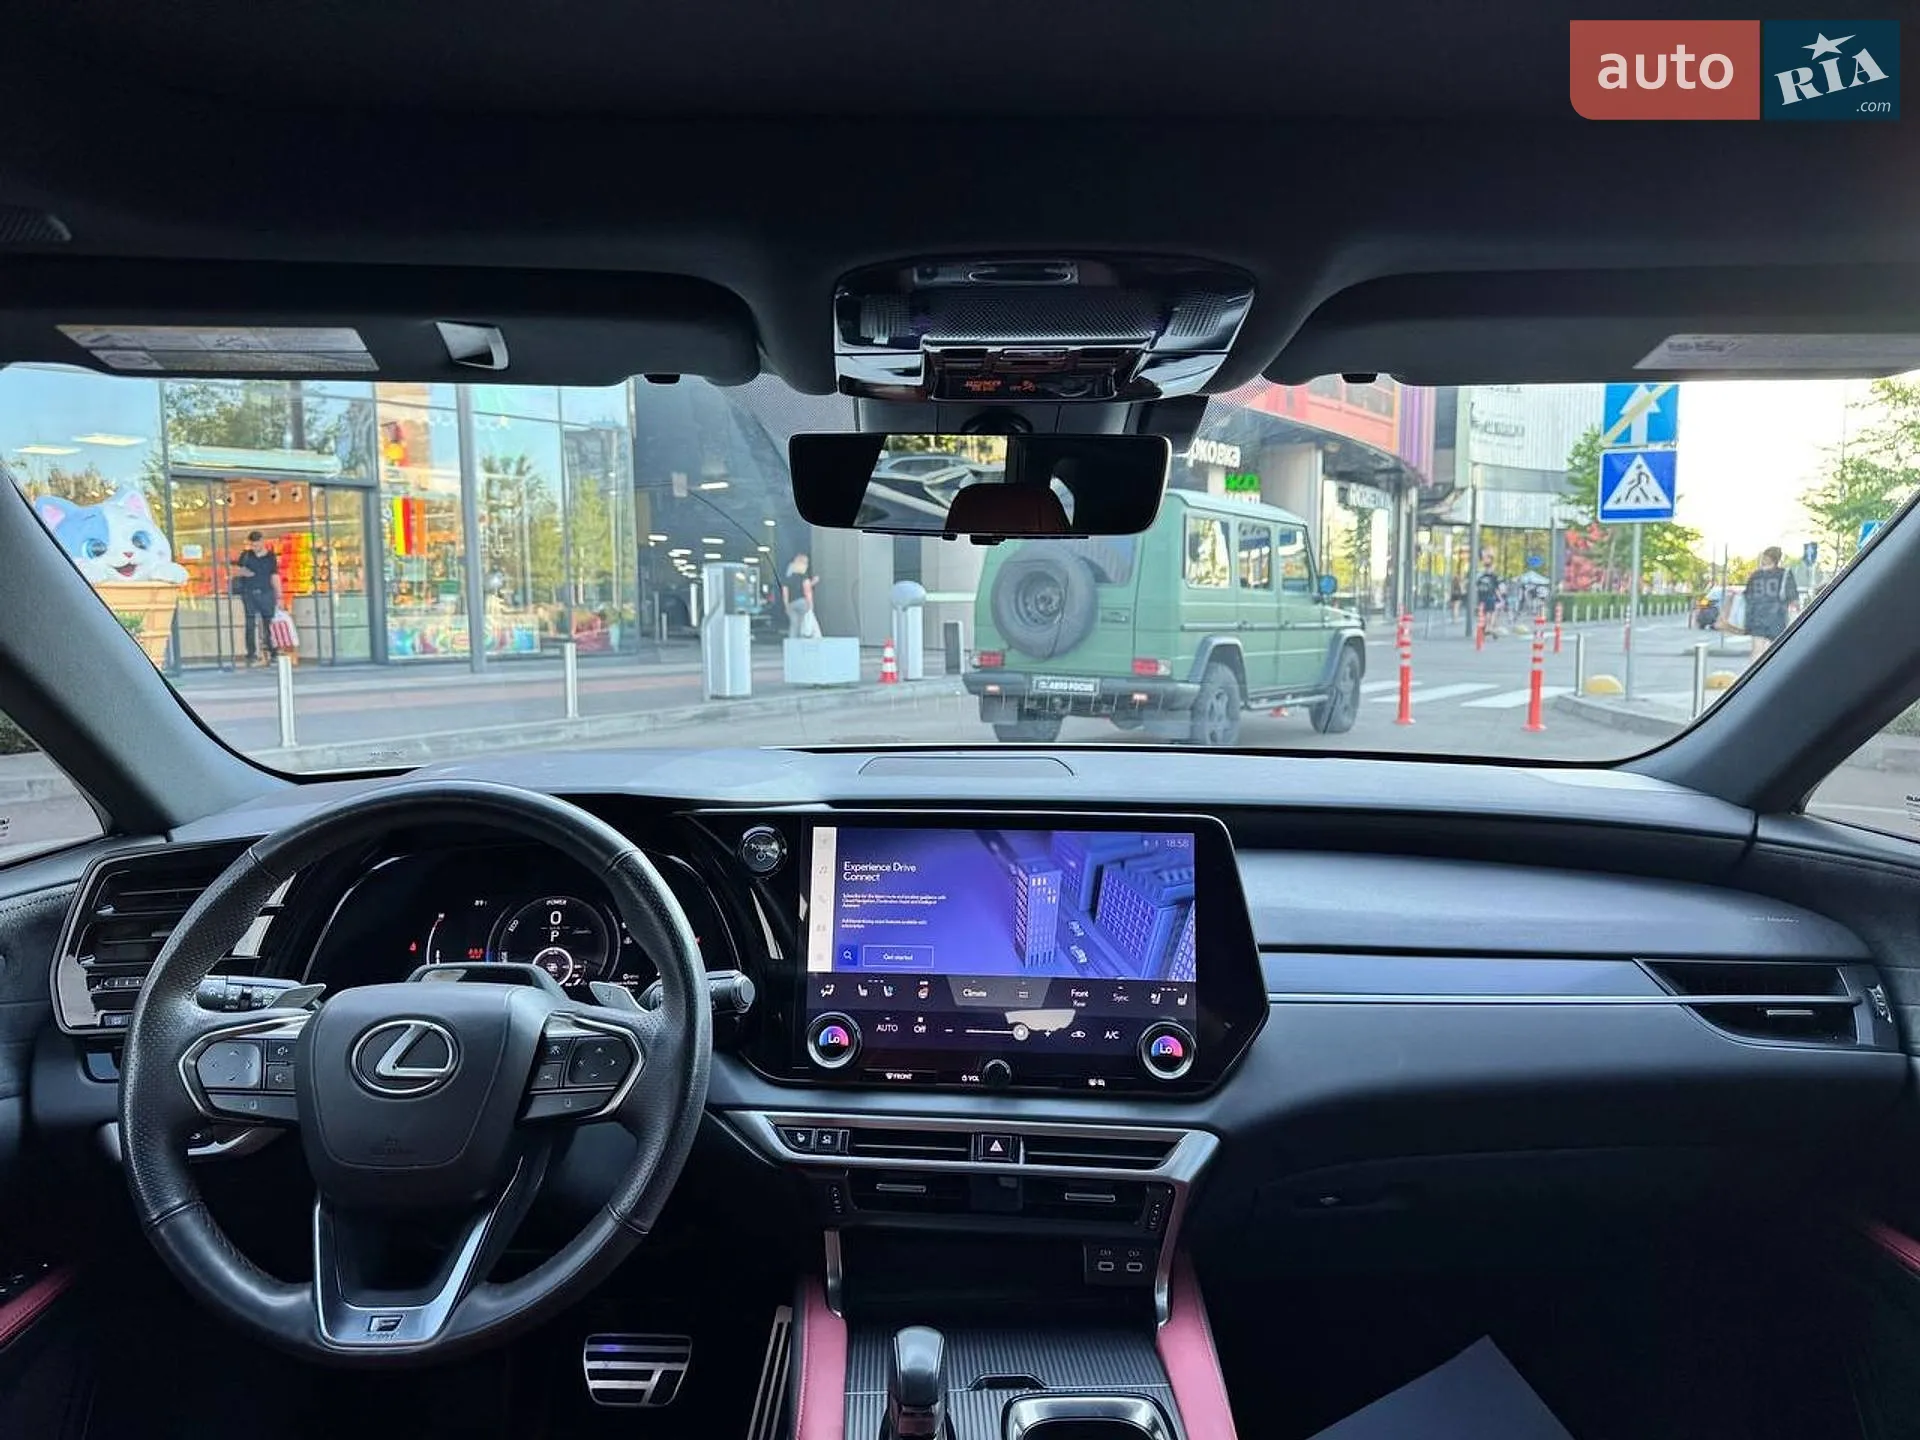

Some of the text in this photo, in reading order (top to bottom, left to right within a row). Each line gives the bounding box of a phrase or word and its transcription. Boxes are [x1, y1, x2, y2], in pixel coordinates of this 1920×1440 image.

[844, 861, 917, 873] Experience Drive
[843, 872, 880, 882] Connect
[550, 930, 560, 942] P
[962, 988, 988, 998] Climate
[1070, 988, 1089, 999] Front
[875, 1023, 899, 1033] AUTO
[913, 1024, 927, 1034] Off
[827, 1033, 840, 1044] Lo
[1104, 1030, 1121, 1040] A/C
[1159, 1043, 1173, 1055] Lo
